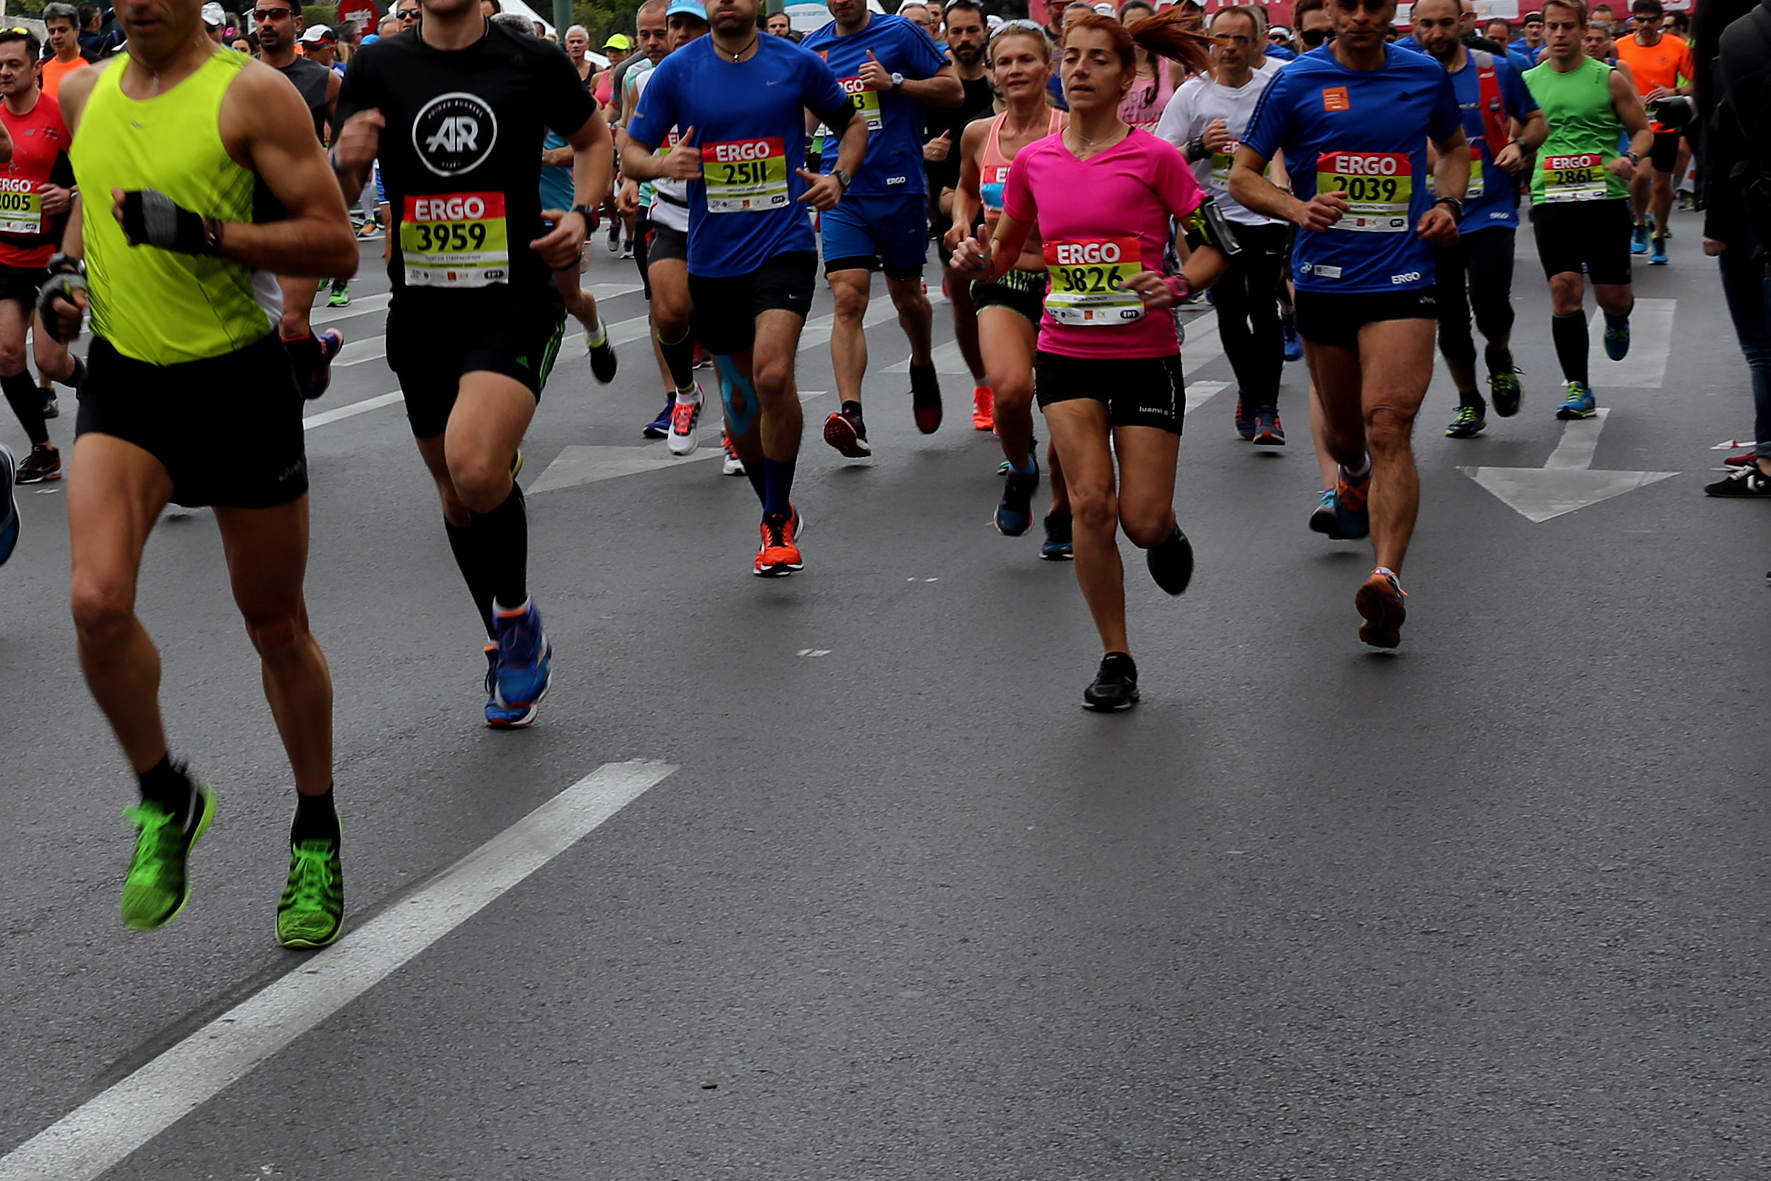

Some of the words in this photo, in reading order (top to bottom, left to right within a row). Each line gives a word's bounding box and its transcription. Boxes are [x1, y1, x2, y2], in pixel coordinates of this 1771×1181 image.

[716, 141, 770, 162] ERGO
[1552, 155, 1592, 170] ERGO
[722, 161, 767, 185] 2511
[1335, 155, 1397, 175] ERGO
[1554, 168, 1593, 185] 2861
[1333, 176, 1397, 202] 2039
[415, 196, 485, 222] ERGO
[415, 222, 487, 251] 3959
[1056, 242, 1121, 265] ERGO
[1059, 265, 1124, 293] 3826
[1391, 271, 1421, 285] ERGO
